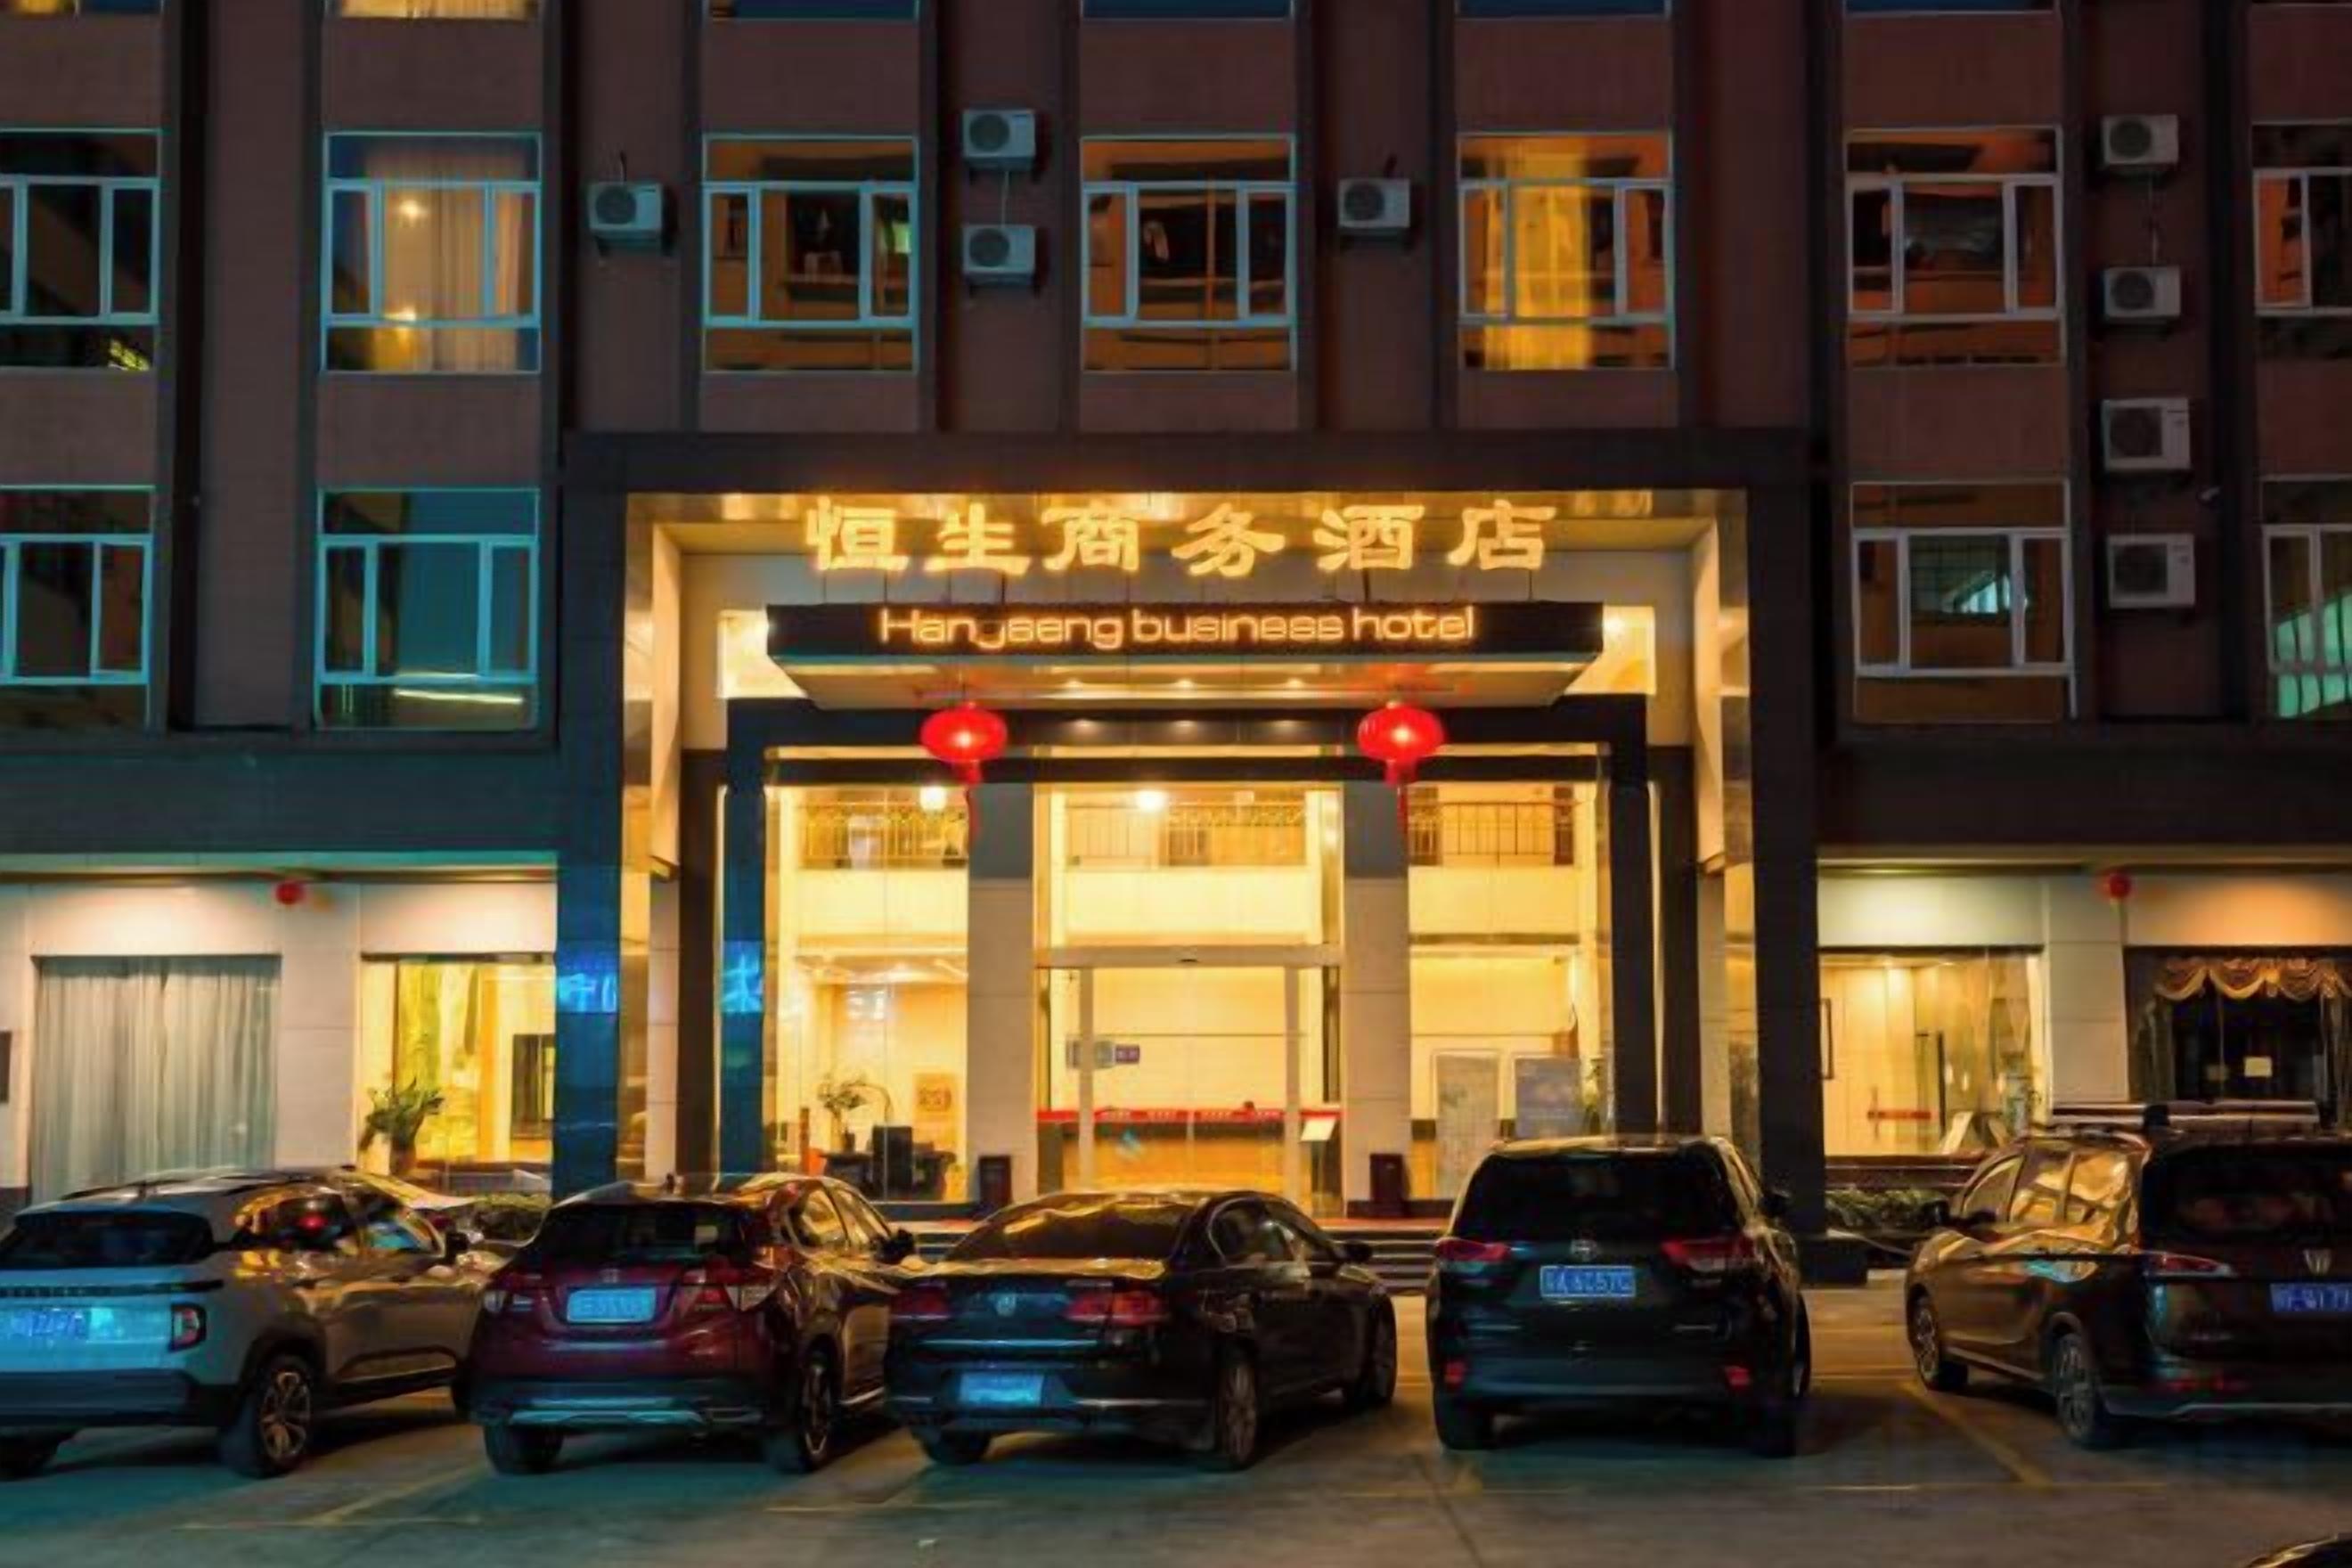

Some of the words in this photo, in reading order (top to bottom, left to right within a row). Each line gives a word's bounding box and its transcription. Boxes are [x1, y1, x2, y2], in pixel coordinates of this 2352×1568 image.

[805, 495, 1557, 576] 恒生商务酒店
[1131, 608, 1345, 642] business
[1352, 606, 1475, 641] hotel
